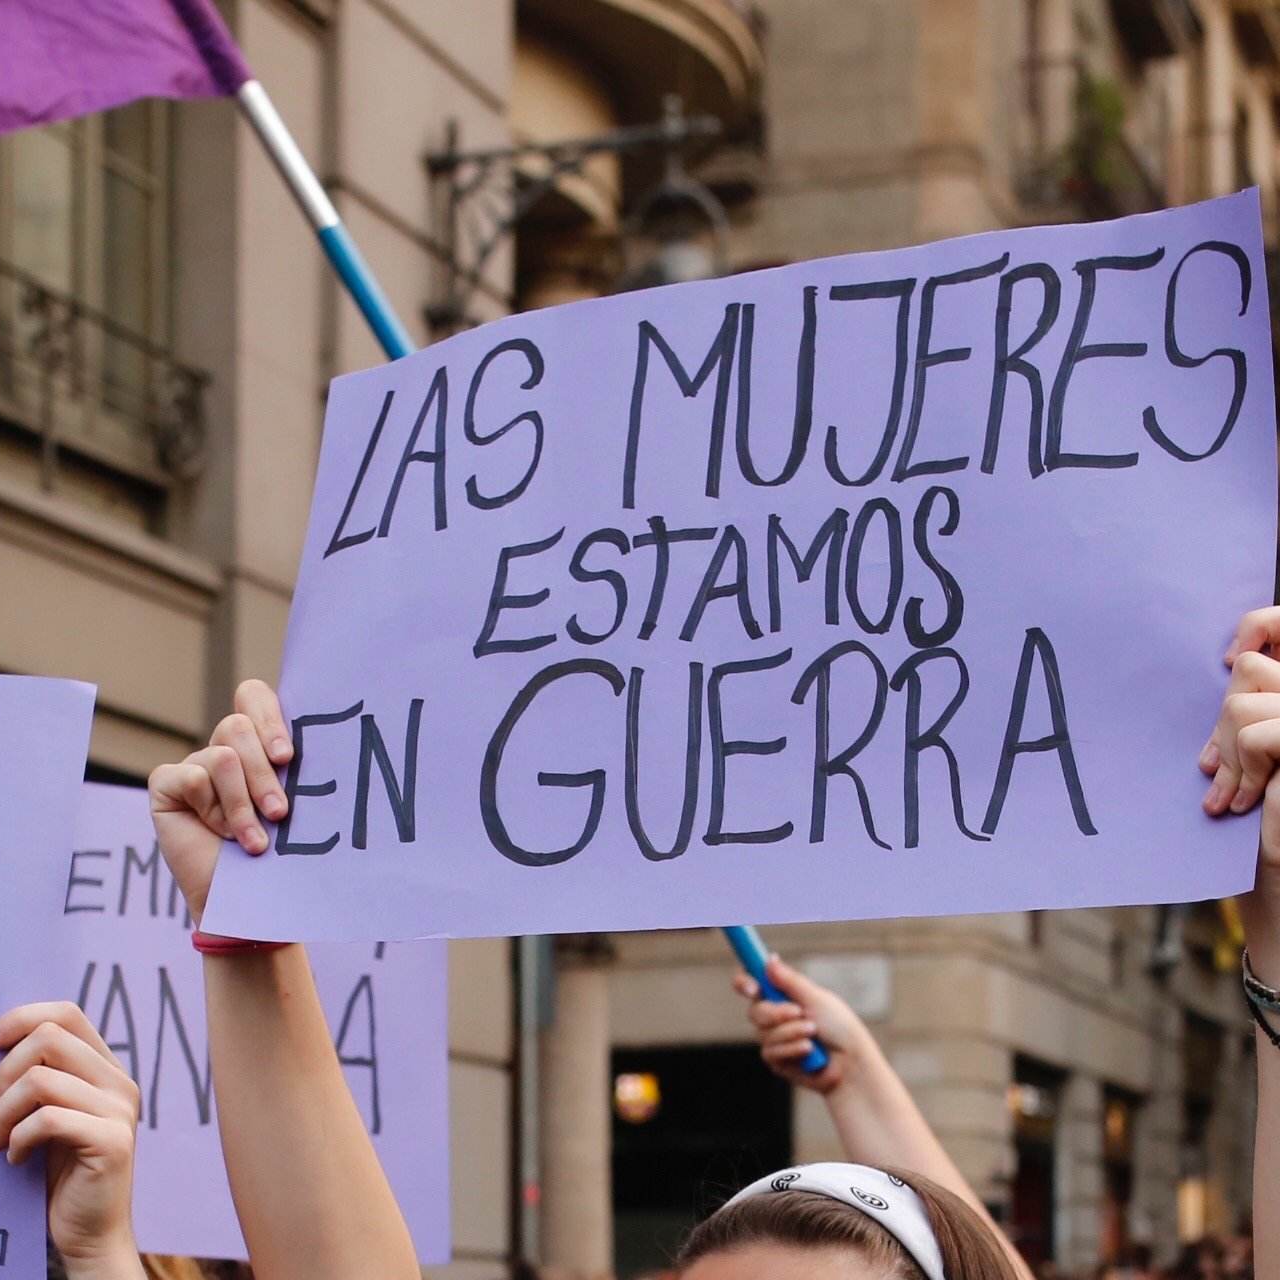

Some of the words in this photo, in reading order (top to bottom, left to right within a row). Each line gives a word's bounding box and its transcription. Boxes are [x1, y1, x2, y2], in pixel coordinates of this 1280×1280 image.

[324, 338, 546, 559] LAS
[622, 240, 1252, 510] MUJERES
[472, 484, 964, 657] ESTAMOS
[274, 698, 424, 856] EN
[478, 626, 1098, 867] GUERRA
